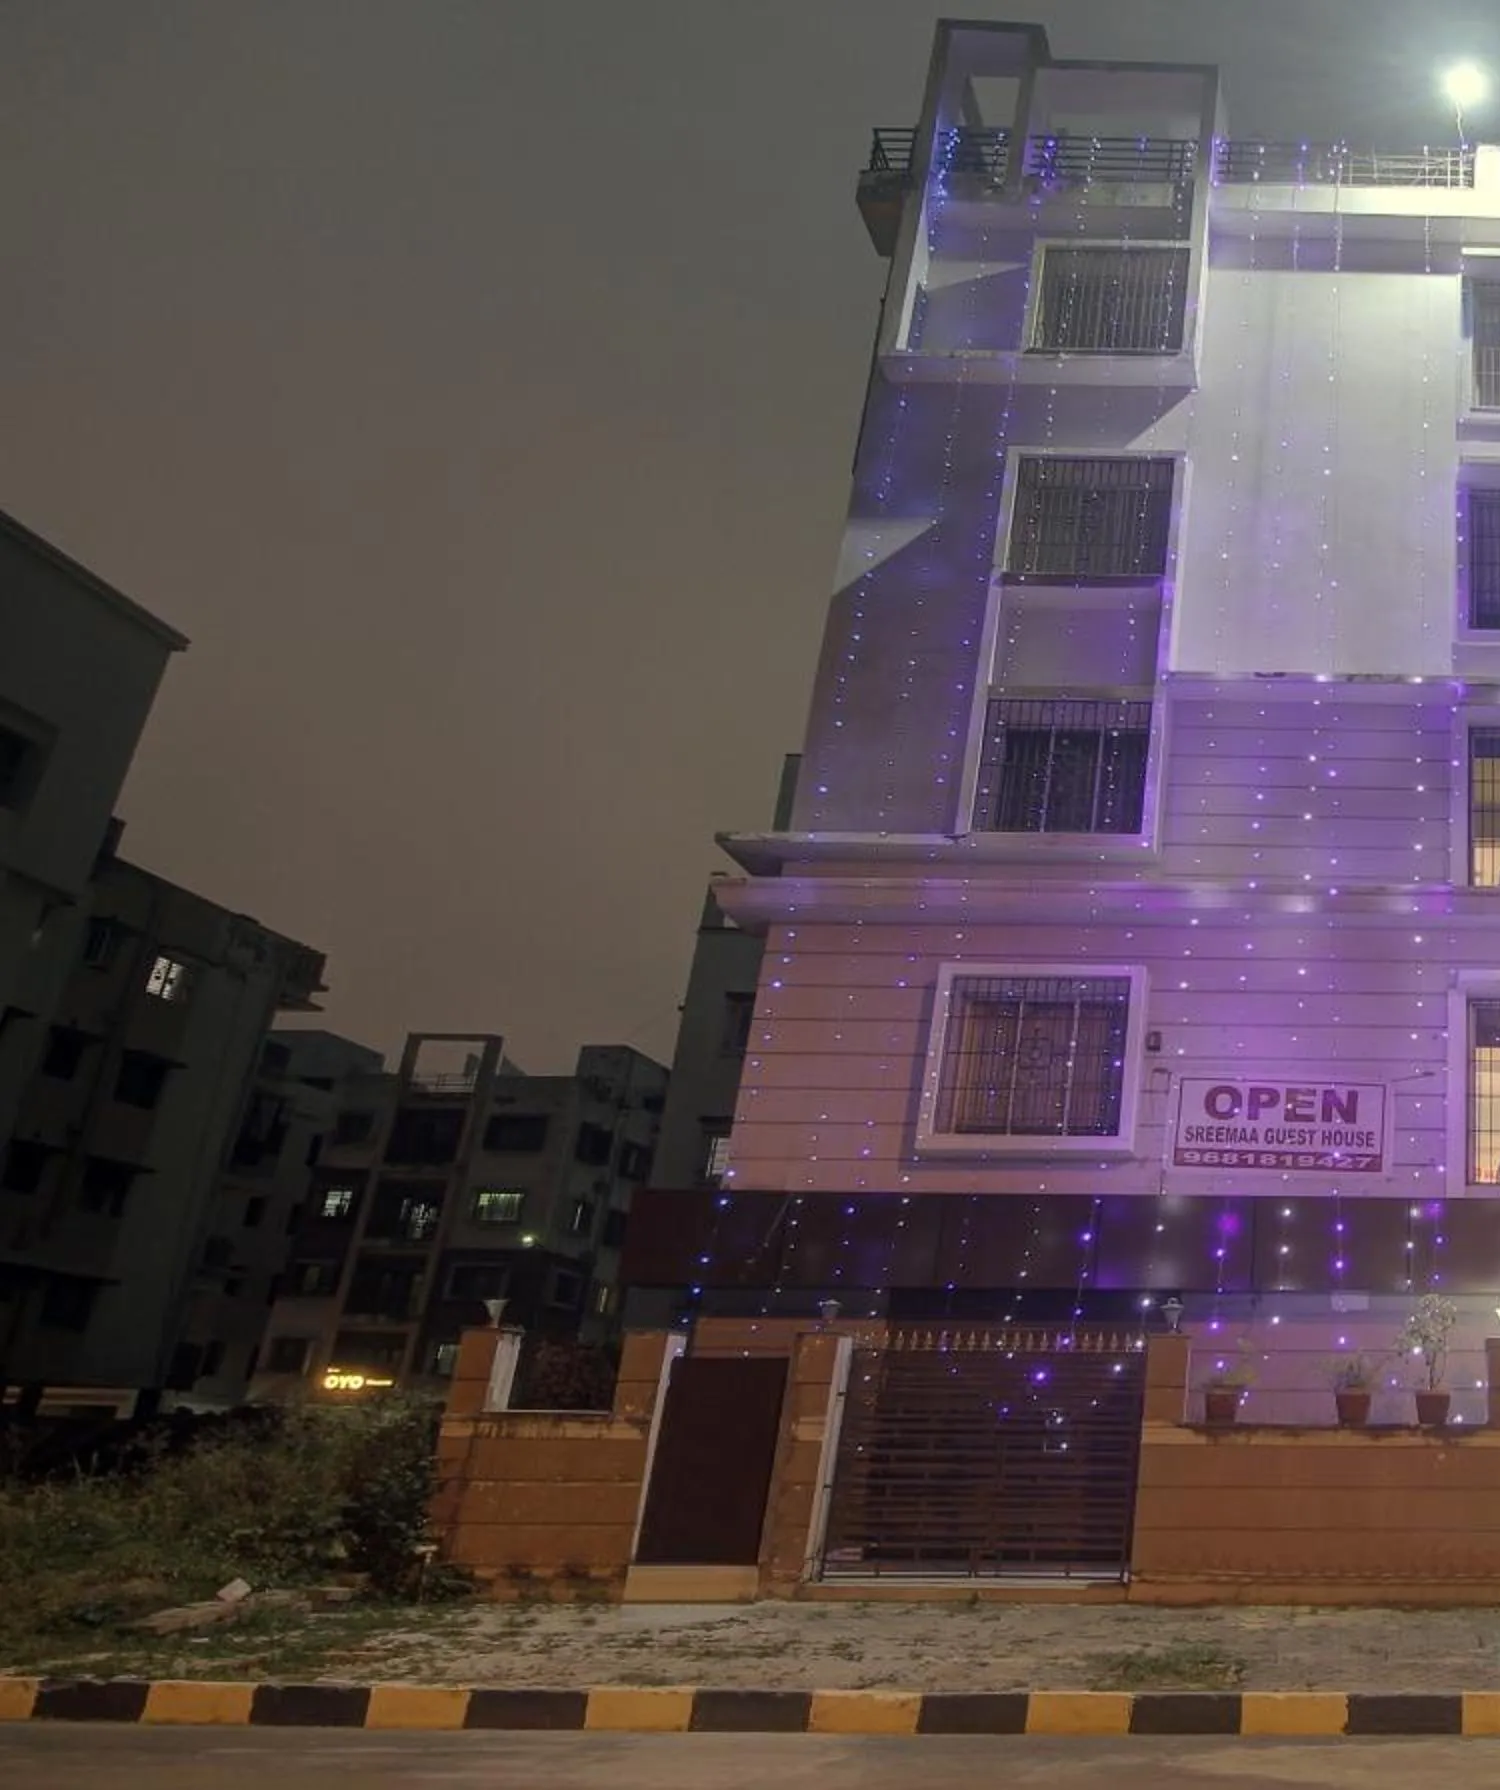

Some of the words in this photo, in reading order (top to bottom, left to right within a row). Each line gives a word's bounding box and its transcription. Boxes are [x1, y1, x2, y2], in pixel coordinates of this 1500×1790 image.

[1204, 1085, 1359, 1124] OPEN
[1184, 1125, 1259, 1144] SREEMAA
[1264, 1128, 1317, 1145] GUEST
[1321, 1129, 1375, 1148] HOUSE
[324, 1375, 364, 1389] OYO
